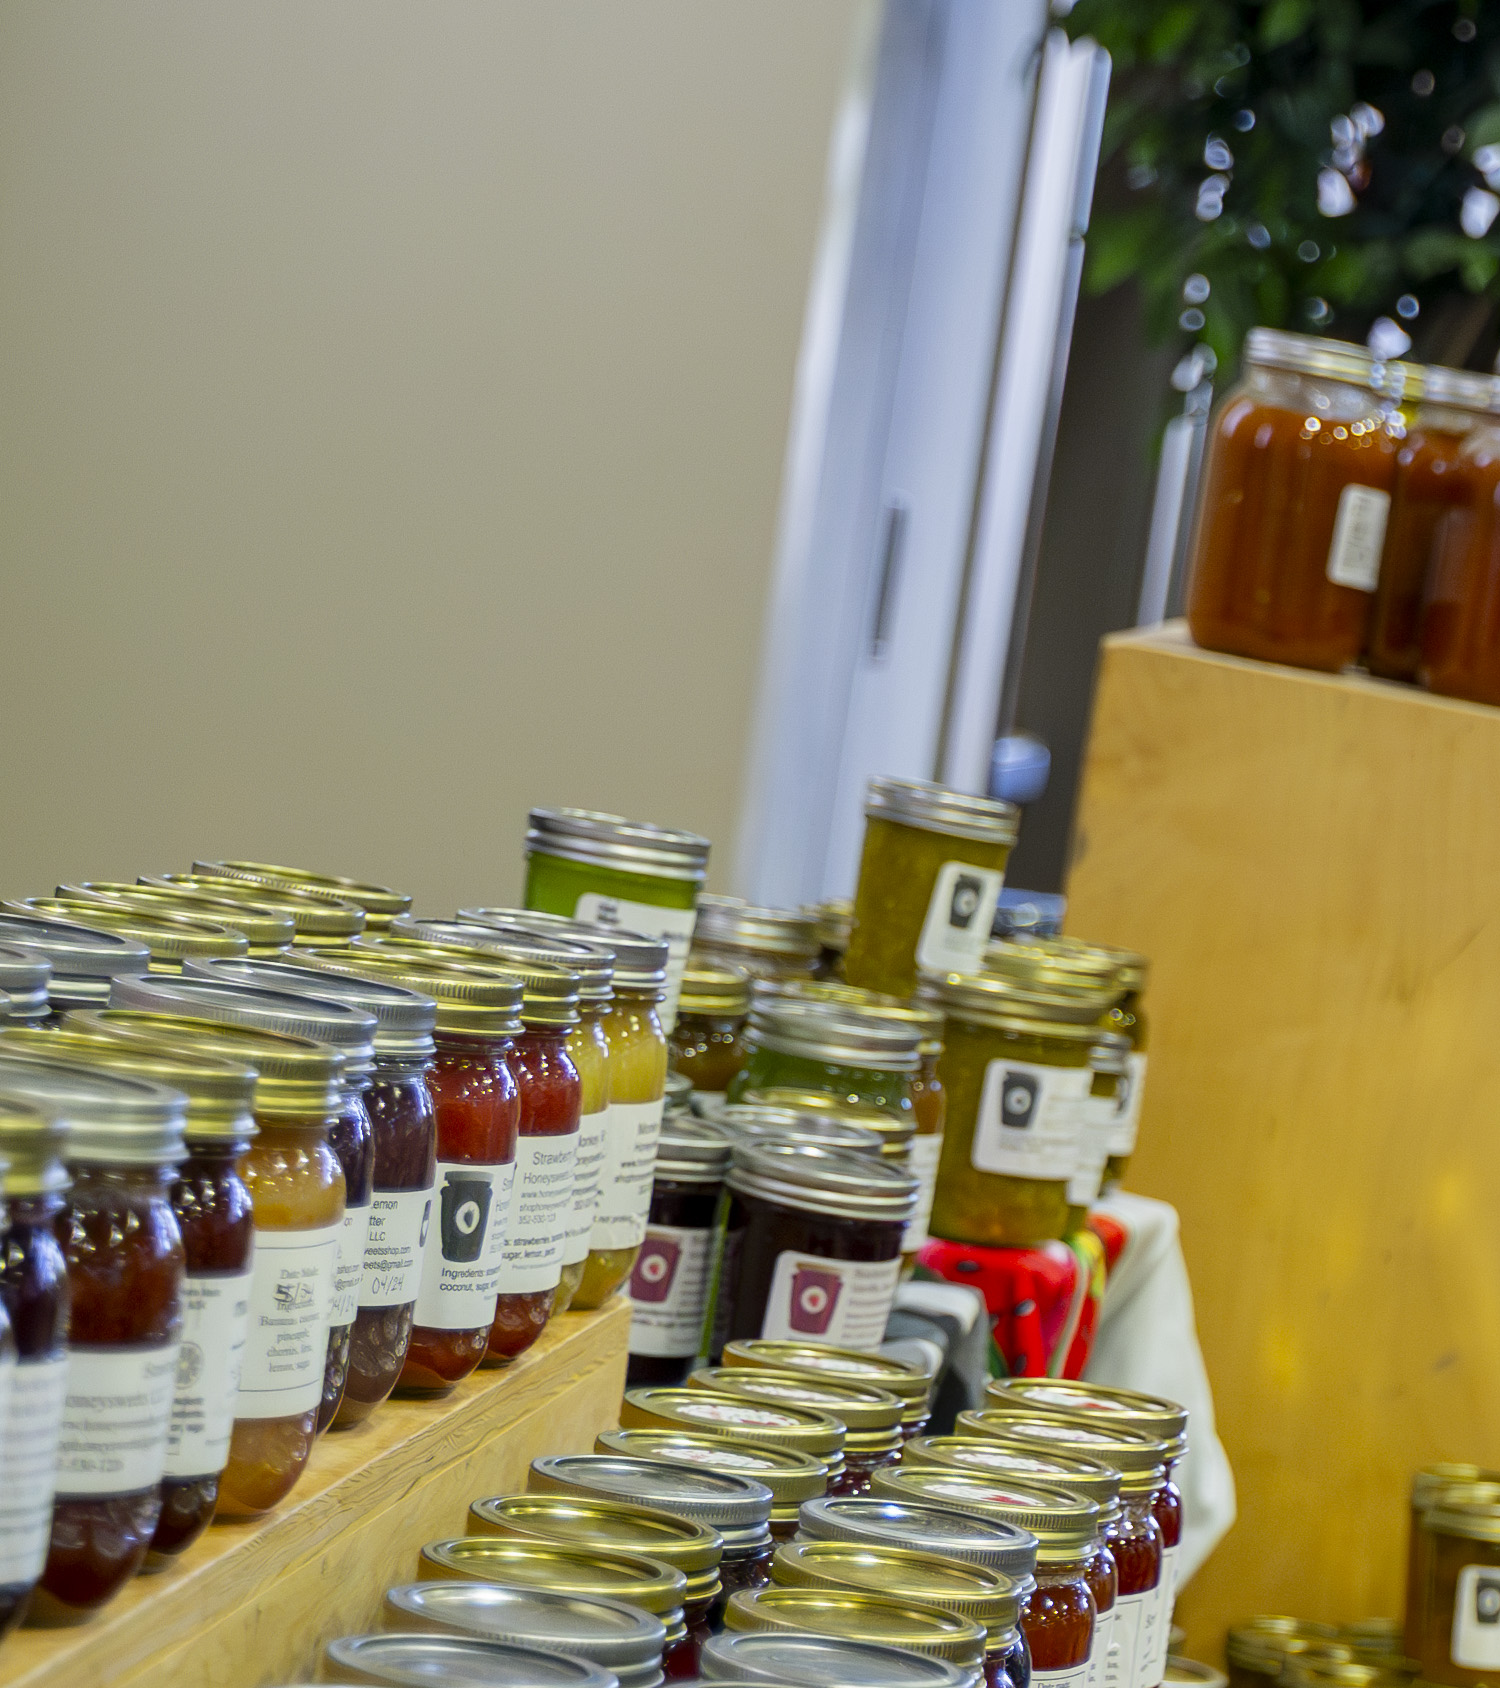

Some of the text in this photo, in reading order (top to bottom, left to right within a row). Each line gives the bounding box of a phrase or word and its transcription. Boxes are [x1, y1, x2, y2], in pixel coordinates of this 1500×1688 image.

[369, 1201, 398, 1210] emon
[368, 1215, 387, 1226] tter
[369, 1232, 386, 1242] LLC
